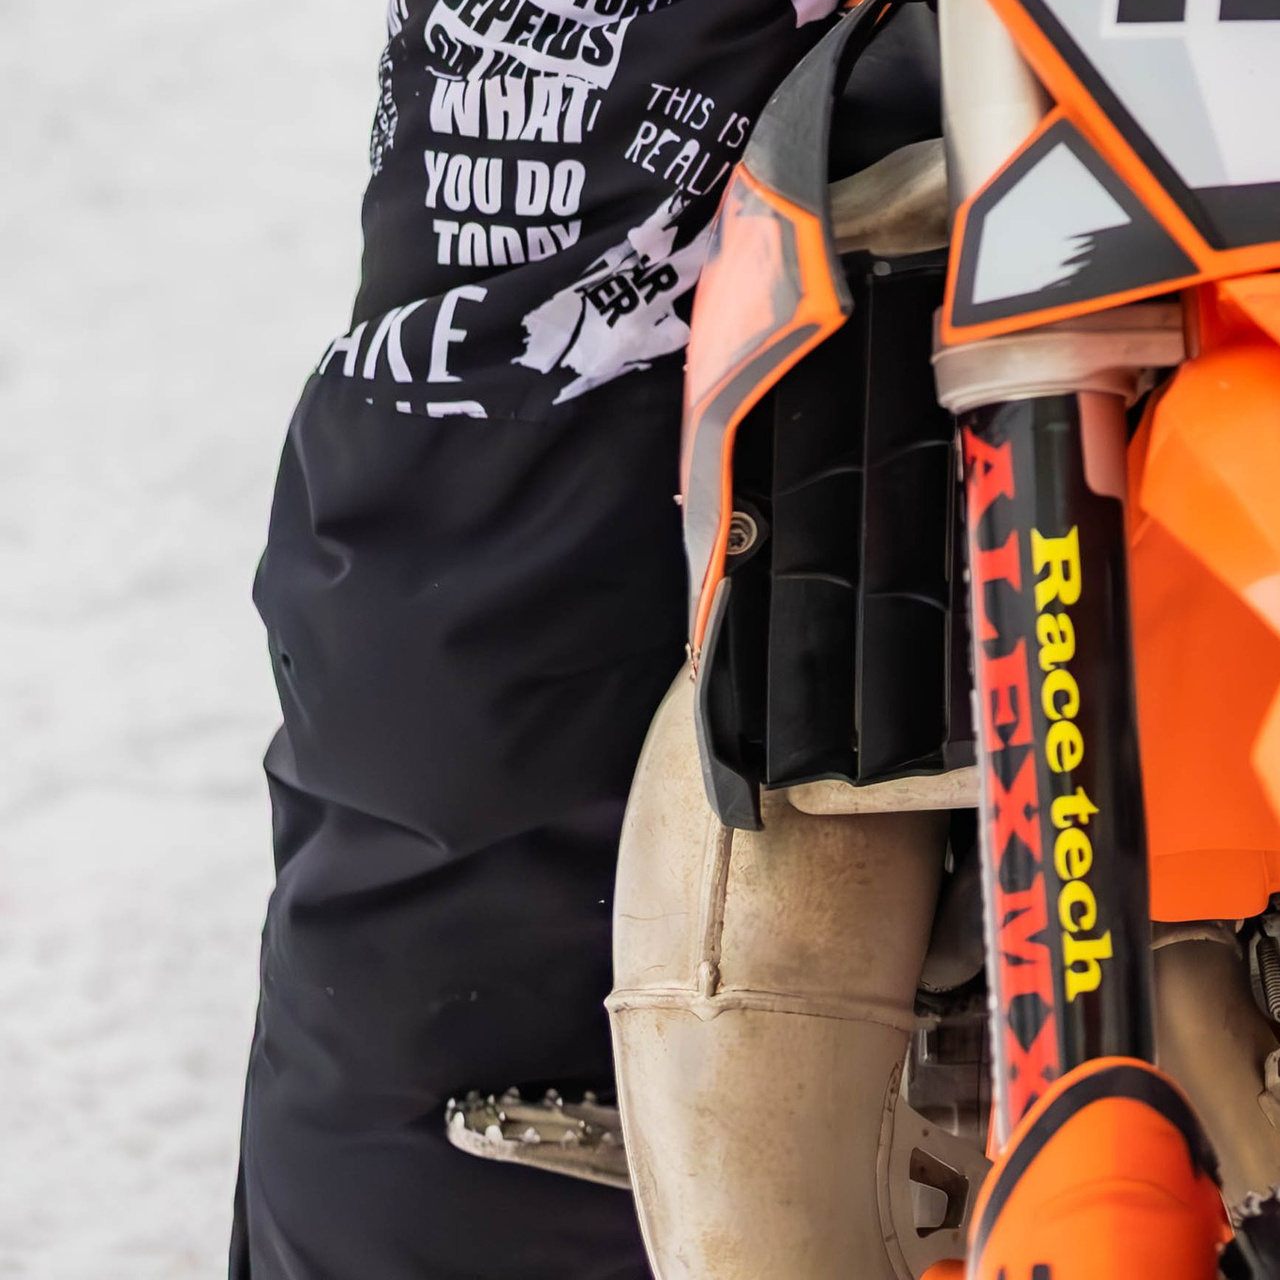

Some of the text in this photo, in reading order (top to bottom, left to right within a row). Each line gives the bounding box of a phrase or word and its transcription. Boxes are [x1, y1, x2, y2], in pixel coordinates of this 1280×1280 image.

[428, 74, 593, 144] WHAT
[650, 82, 751, 149] THIS IS
[423, 149, 587, 217] YOU DO
[1030, 524, 1115, 1003] Race tech
